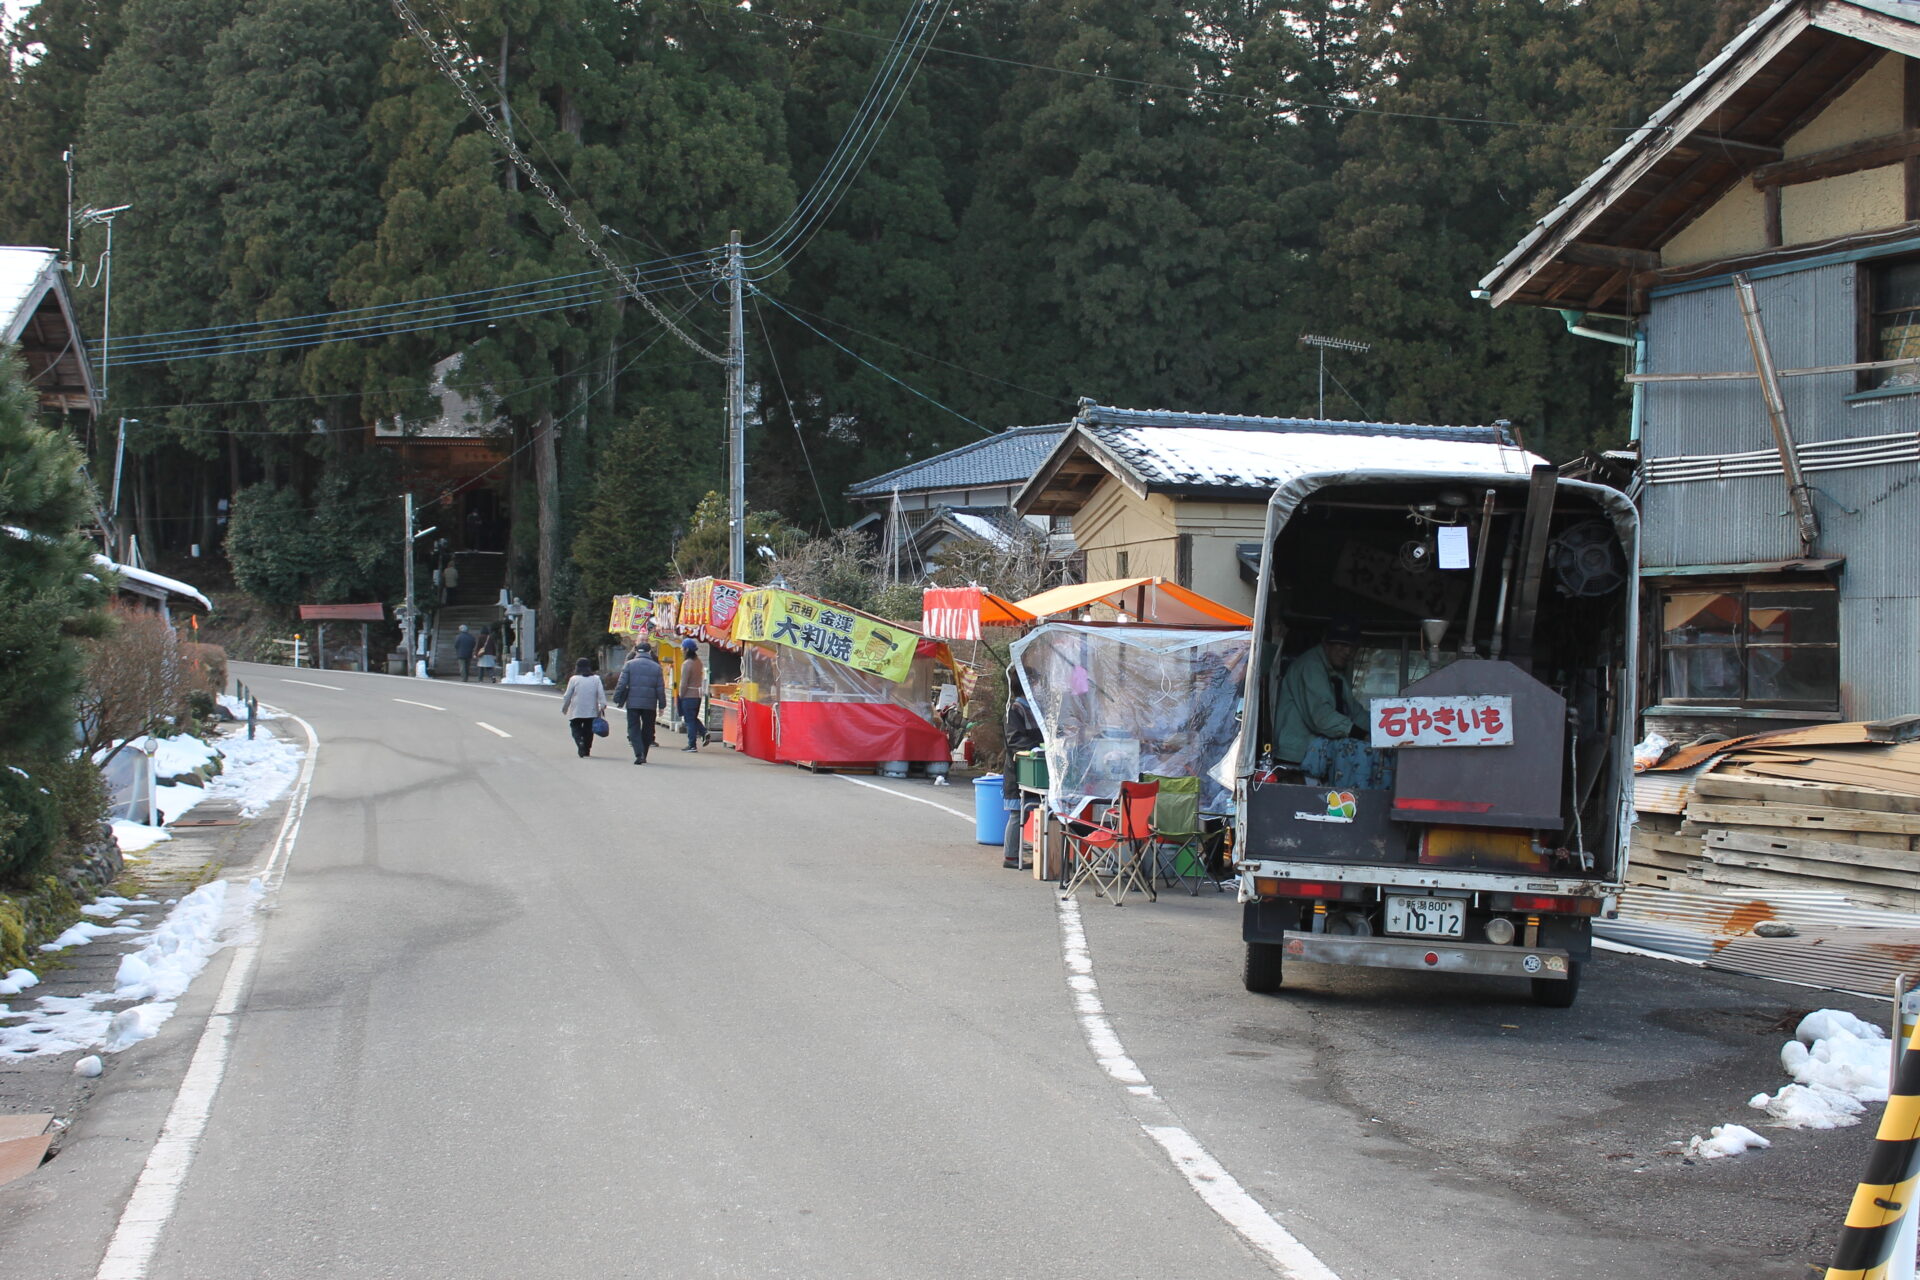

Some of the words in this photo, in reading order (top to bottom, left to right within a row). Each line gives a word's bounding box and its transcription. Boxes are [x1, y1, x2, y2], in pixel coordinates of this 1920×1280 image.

[789, 601, 814, 618] 元祖
[819, 609, 854, 633] 金運
[772, 615, 853, 662] 大判焼
[1379, 705, 1504, 737] 石やきいも
[1406, 911, 1460, 934] 10-12
